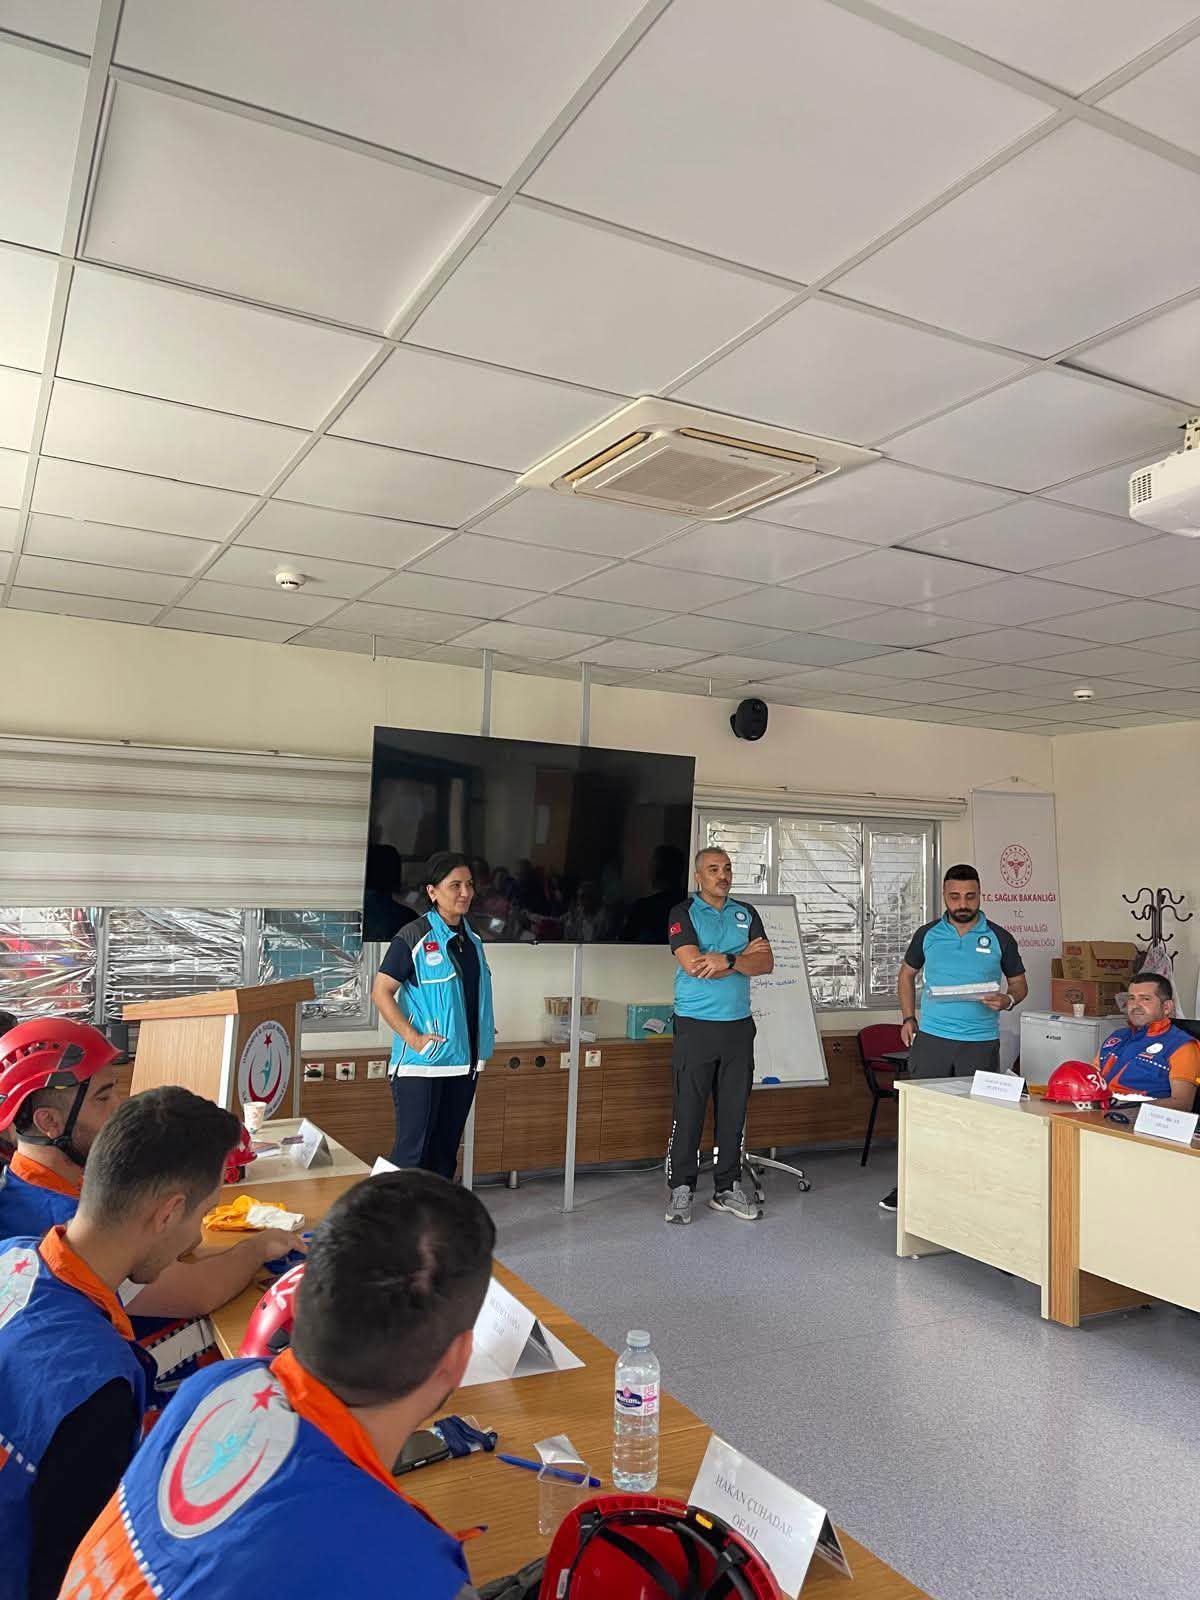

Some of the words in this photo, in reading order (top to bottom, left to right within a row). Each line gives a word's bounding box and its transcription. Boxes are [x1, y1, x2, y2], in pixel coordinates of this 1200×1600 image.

[994, 892, 1018, 902] SAĞLIK
[1019, 891, 1057, 902] BAKANLIĞI
[715, 1473, 746, 1504] HAKAN
[747, 1498, 793, 1538] ÇUHADAR
